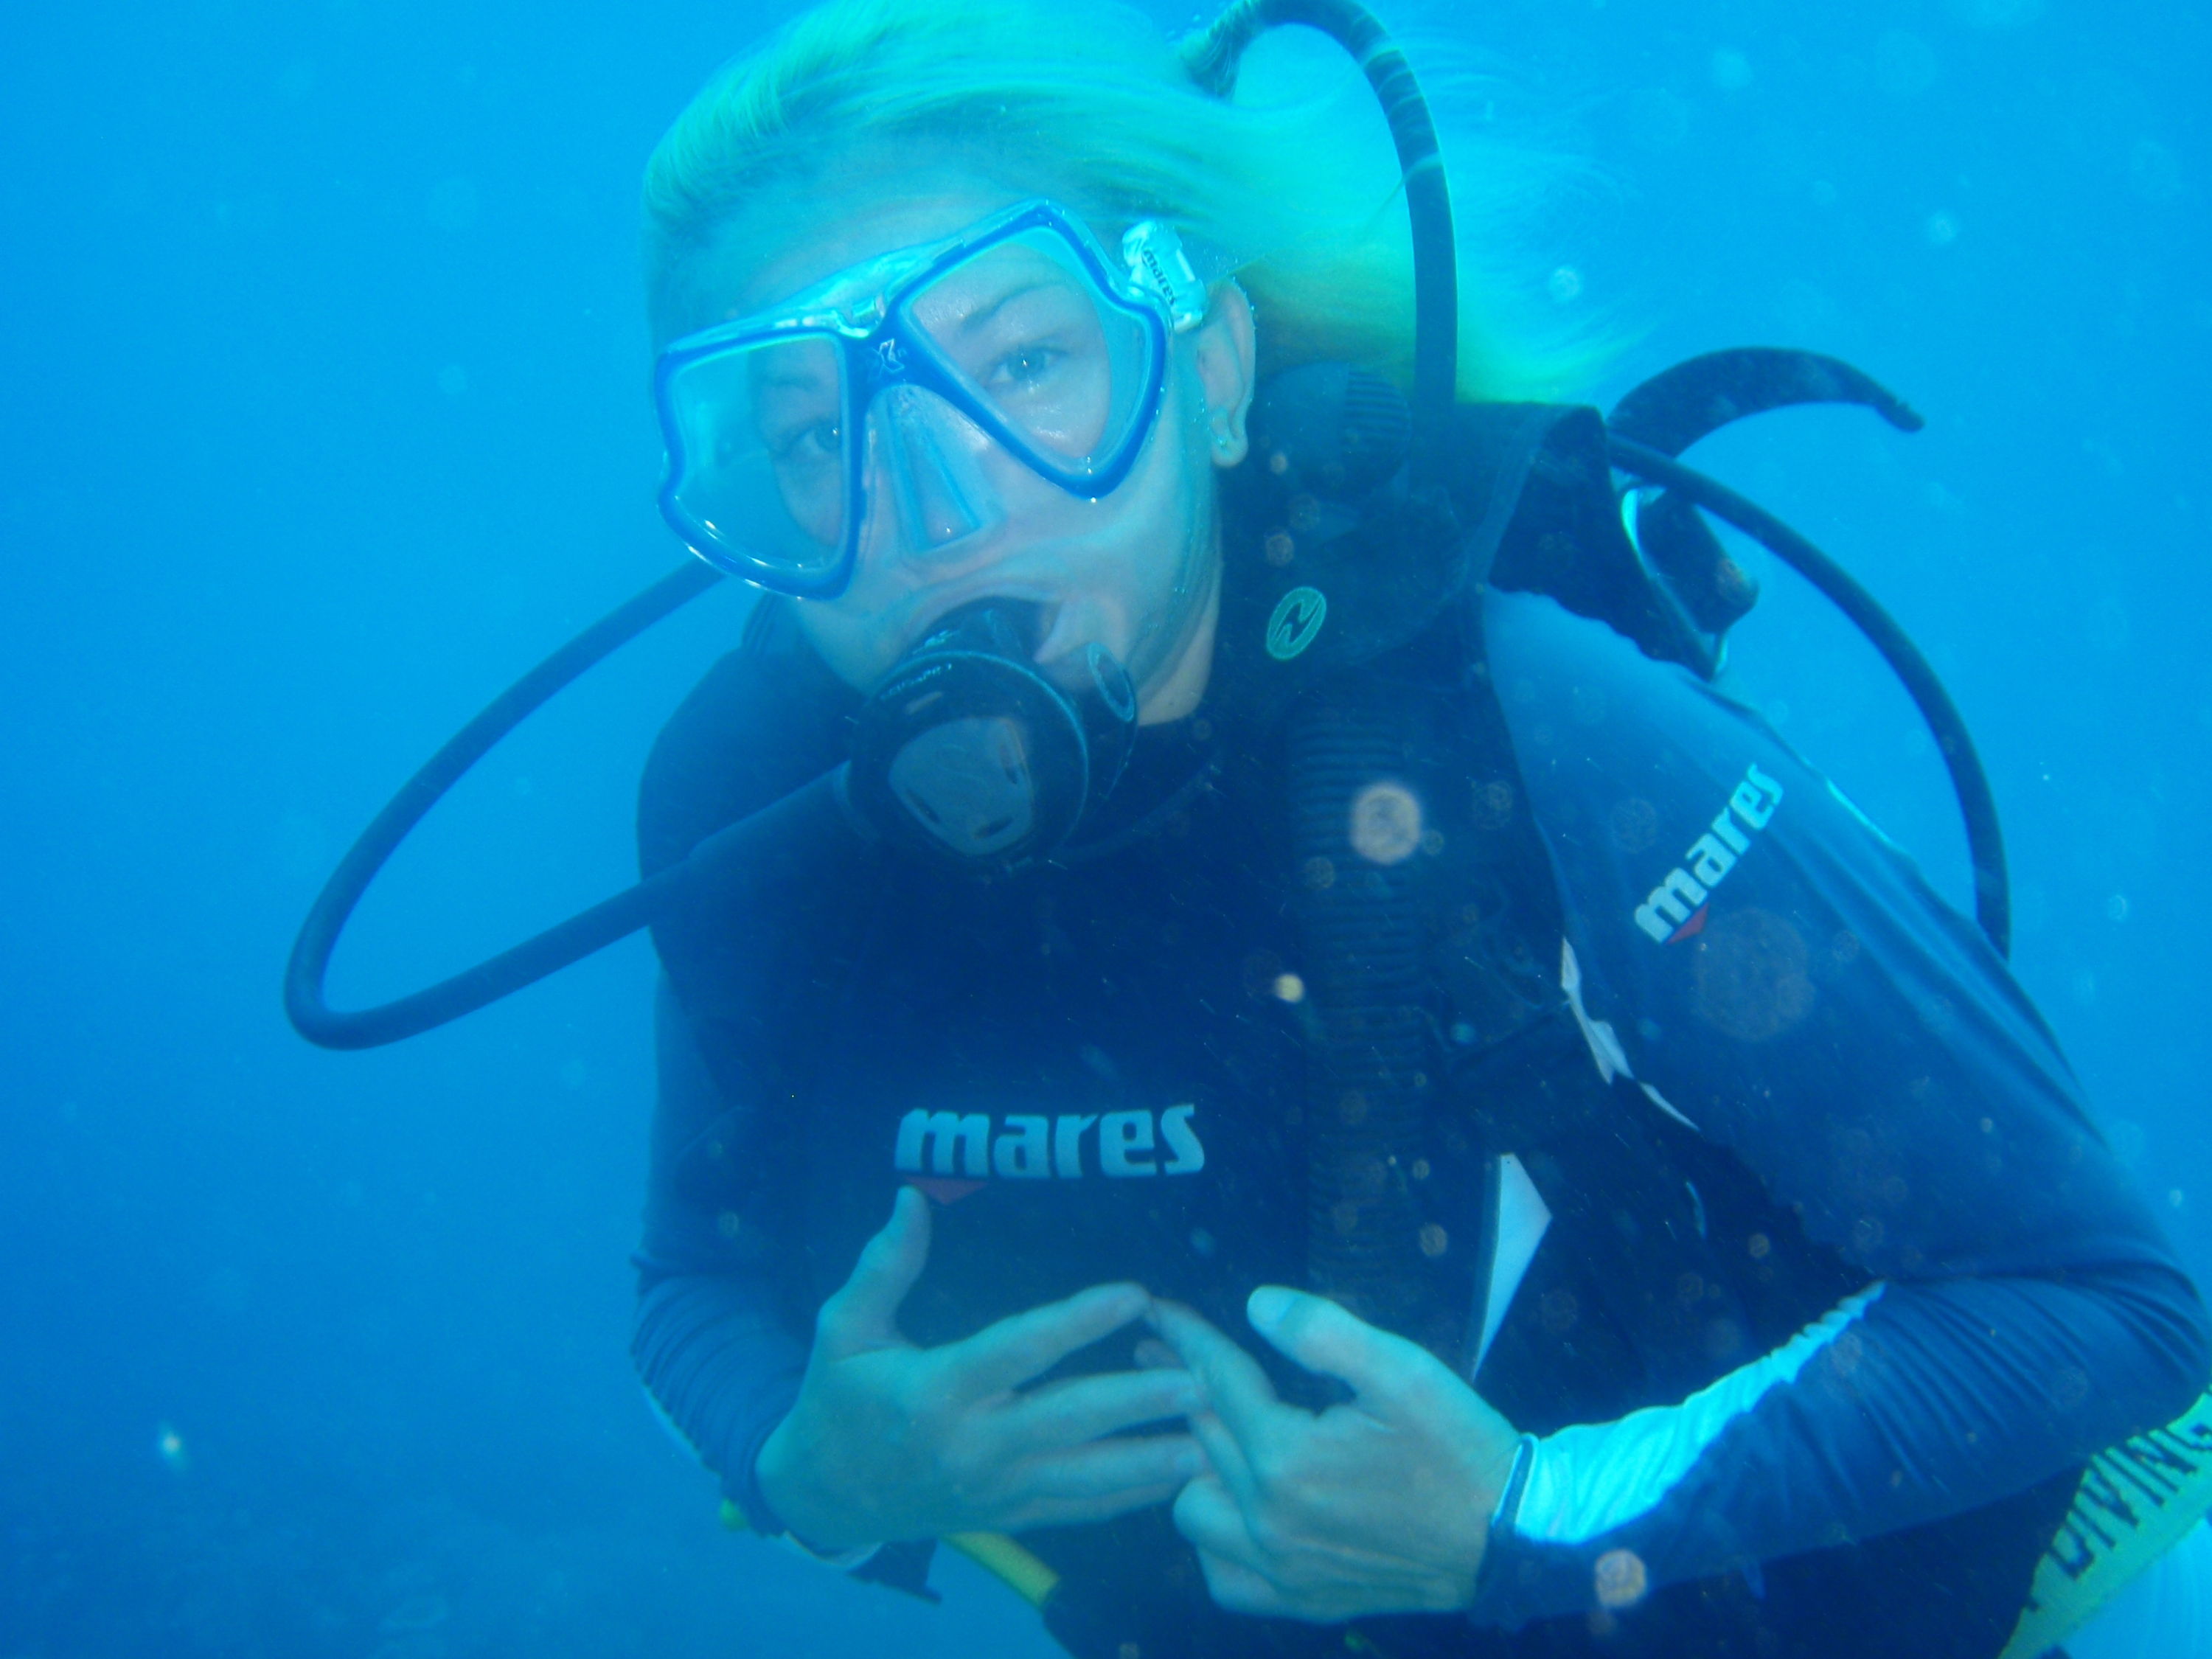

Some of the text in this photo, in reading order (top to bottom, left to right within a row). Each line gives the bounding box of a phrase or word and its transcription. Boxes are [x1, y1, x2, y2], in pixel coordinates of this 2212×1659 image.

[1141, 248, 1175, 305] mares
[1634, 762, 1784, 944] mares
[894, 1104, 1206, 1178] mares
